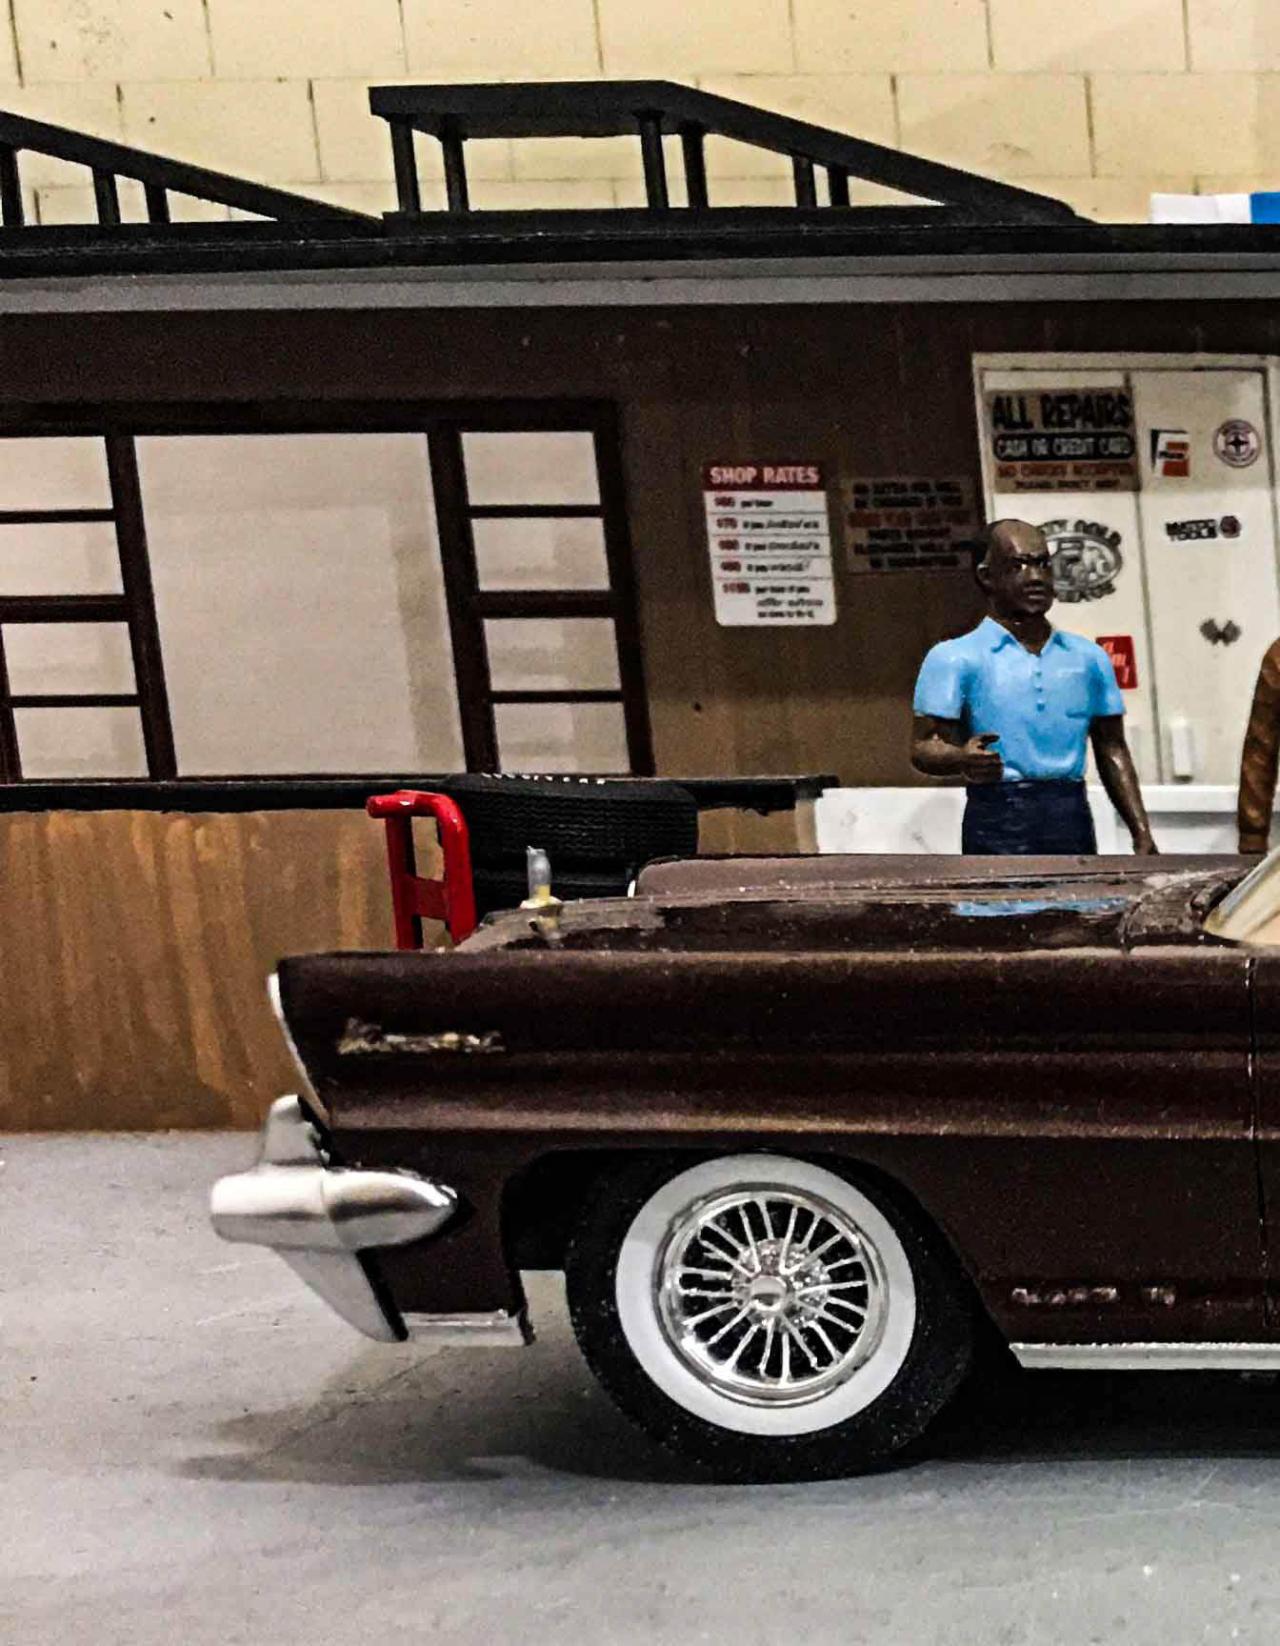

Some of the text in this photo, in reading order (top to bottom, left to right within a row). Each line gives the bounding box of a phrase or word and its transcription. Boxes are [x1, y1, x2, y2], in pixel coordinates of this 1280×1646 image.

[992, 393, 1132, 429] ALL REPAIRS
[710, 466, 819, 483] SHOP RATES
